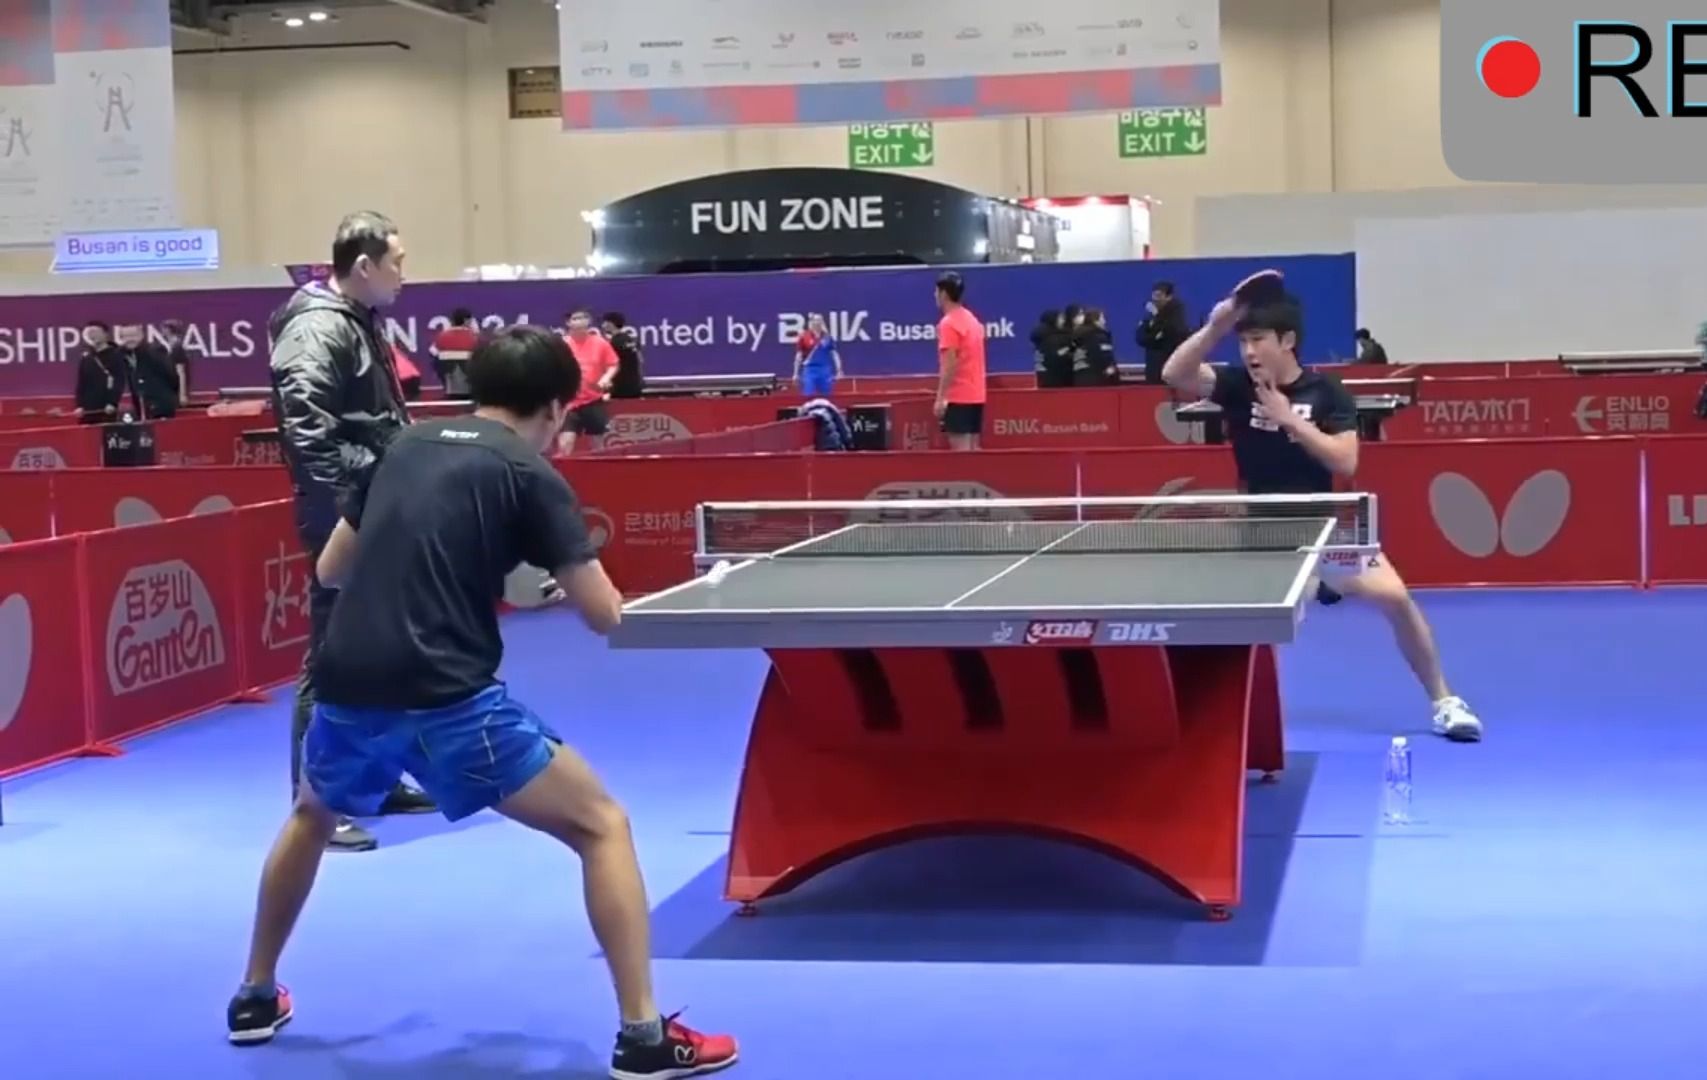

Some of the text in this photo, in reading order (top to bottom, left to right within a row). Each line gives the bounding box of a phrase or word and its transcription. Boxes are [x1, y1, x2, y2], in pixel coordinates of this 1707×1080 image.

[1125, 132, 1176, 153] EXIT
[855, 143, 904, 164] EXIT
[691, 196, 884, 234] FUN ZONE
[68, 236, 202, 258] Busan is good
[728, 316, 767, 352] by
[880, 321, 937, 342] Busa
[1606, 395, 1670, 412] ENLIO
[993, 418, 1040, 435] BNK
[124, 569, 192, 624] 百岁山
[1107, 623, 1176, 641] DHS
[114, 609, 217, 688] Ganten
